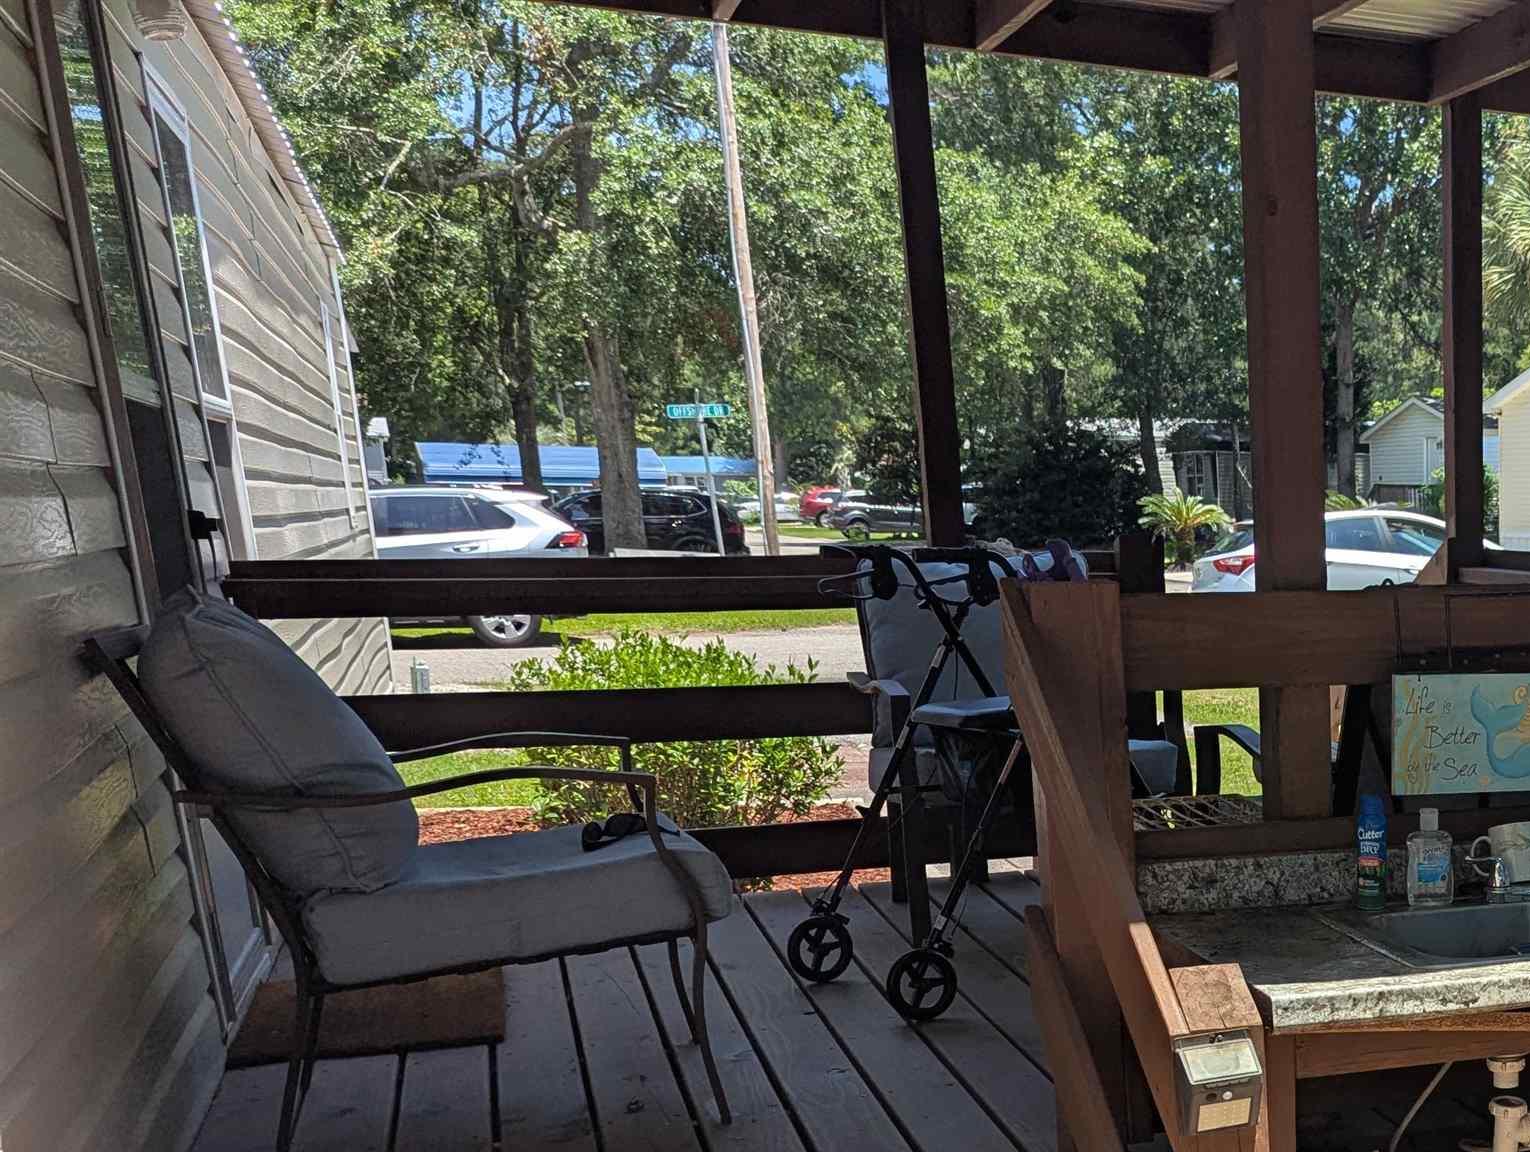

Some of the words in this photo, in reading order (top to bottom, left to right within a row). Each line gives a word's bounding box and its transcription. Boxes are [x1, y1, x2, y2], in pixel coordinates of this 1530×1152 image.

[1405, 686, 1435, 715] Life
[1424, 726, 1480, 749] Better
[1408, 752, 1419, 784] by
[1424, 753, 1440, 773] the
[1440, 757, 1480, 780] Sea
[1357, 827, 1384, 841] Cutter
